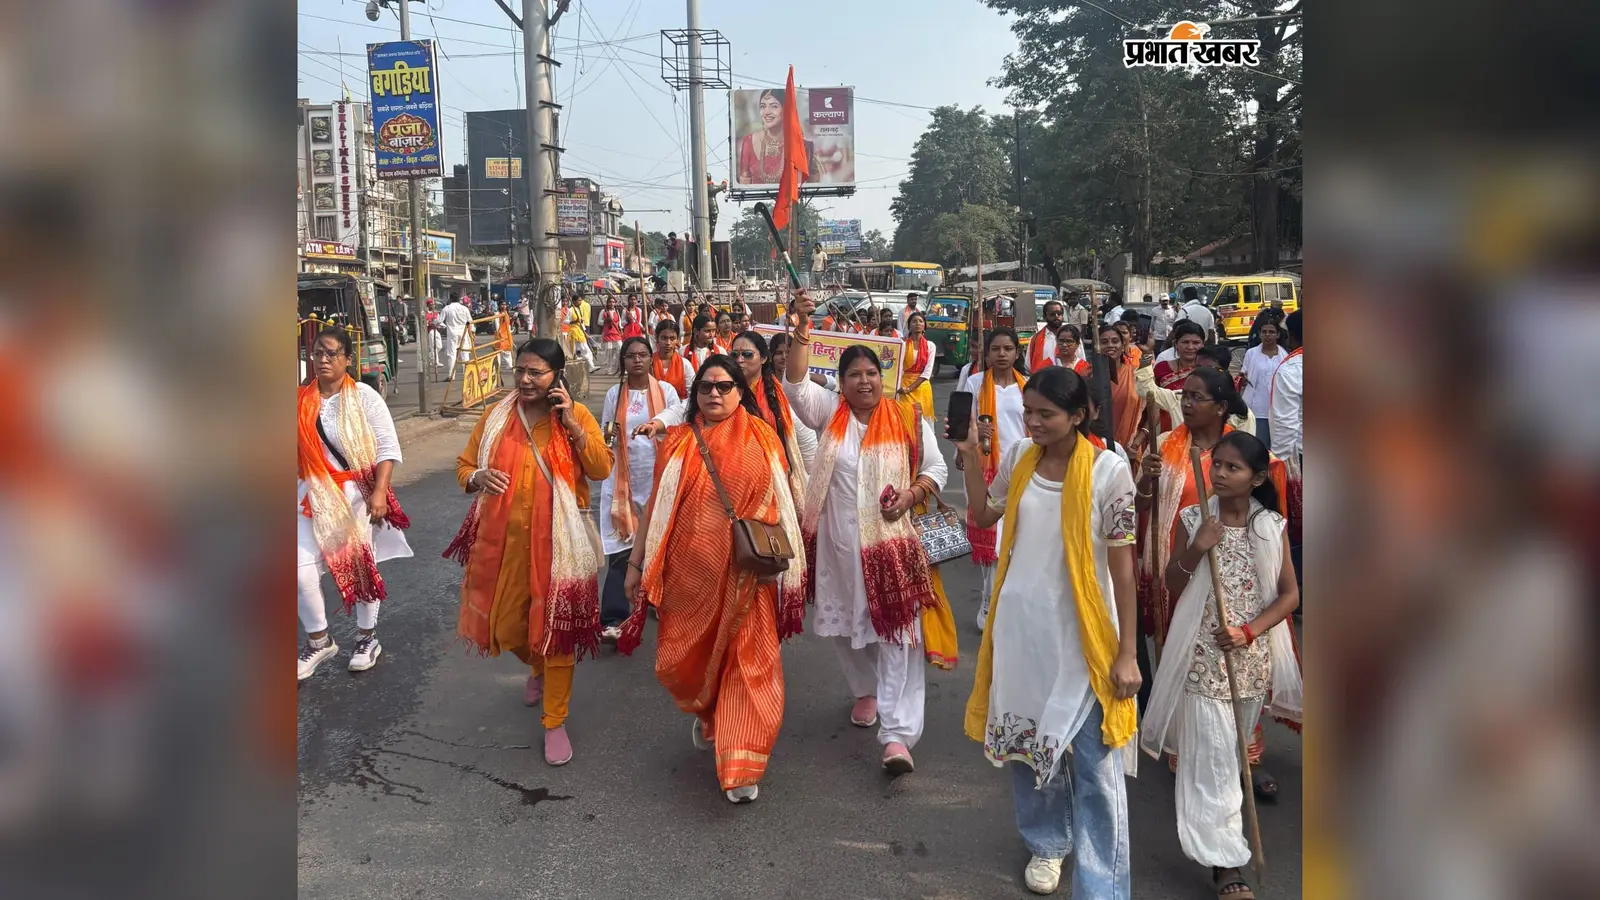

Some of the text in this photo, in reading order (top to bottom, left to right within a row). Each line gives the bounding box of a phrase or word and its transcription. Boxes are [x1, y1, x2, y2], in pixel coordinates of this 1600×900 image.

[370, 61, 430, 101] बगड़िया
[388, 122, 422, 137] पूजा
[338, 103, 350, 229] SHALIMAR SWEETS
[305, 242, 323, 254] ATM
[812, 341, 836, 361] हिन्दू
